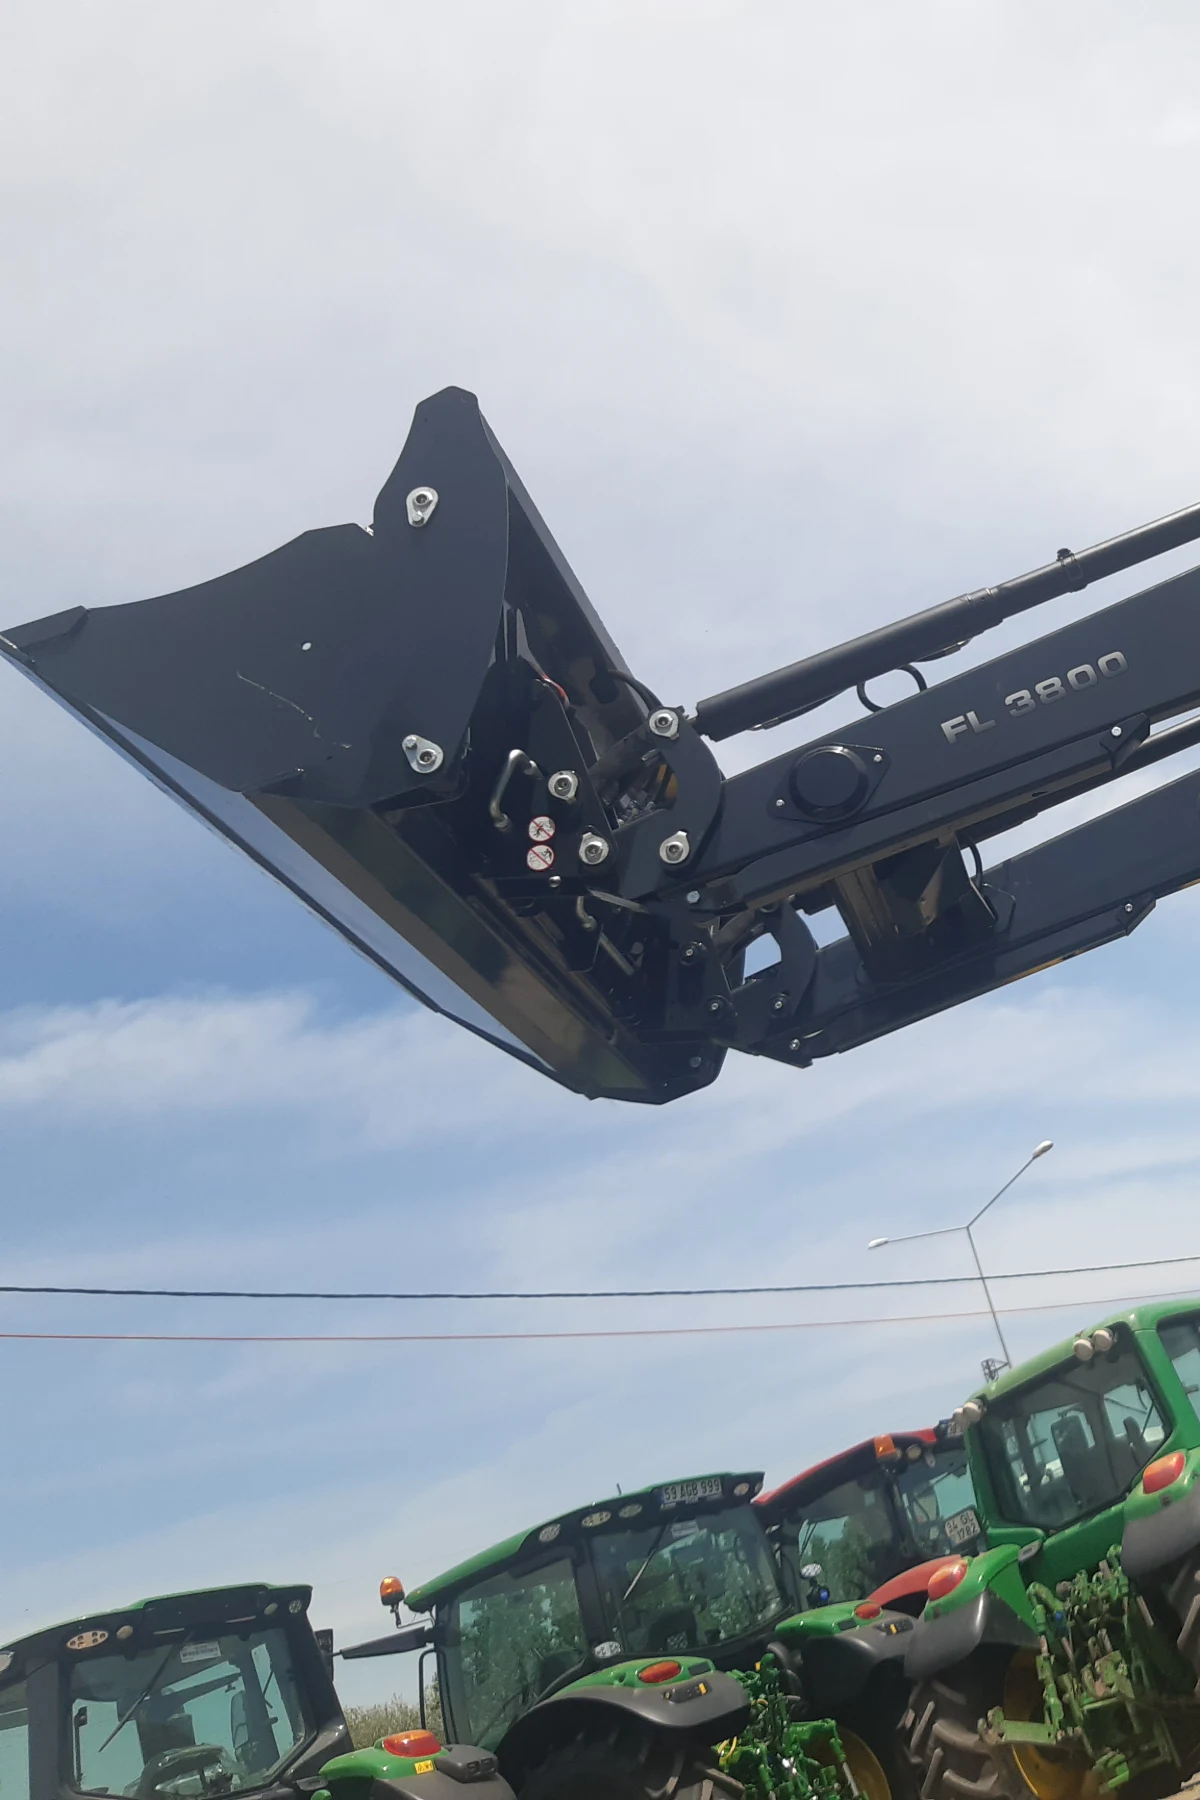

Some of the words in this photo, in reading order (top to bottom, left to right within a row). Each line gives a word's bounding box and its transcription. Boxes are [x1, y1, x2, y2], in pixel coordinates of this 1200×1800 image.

[941, 710, 997, 744] FL
[1004, 651, 1129, 718] 3800
[663, 1486, 677, 1501] 59
[700, 1478, 721, 1494] 999
